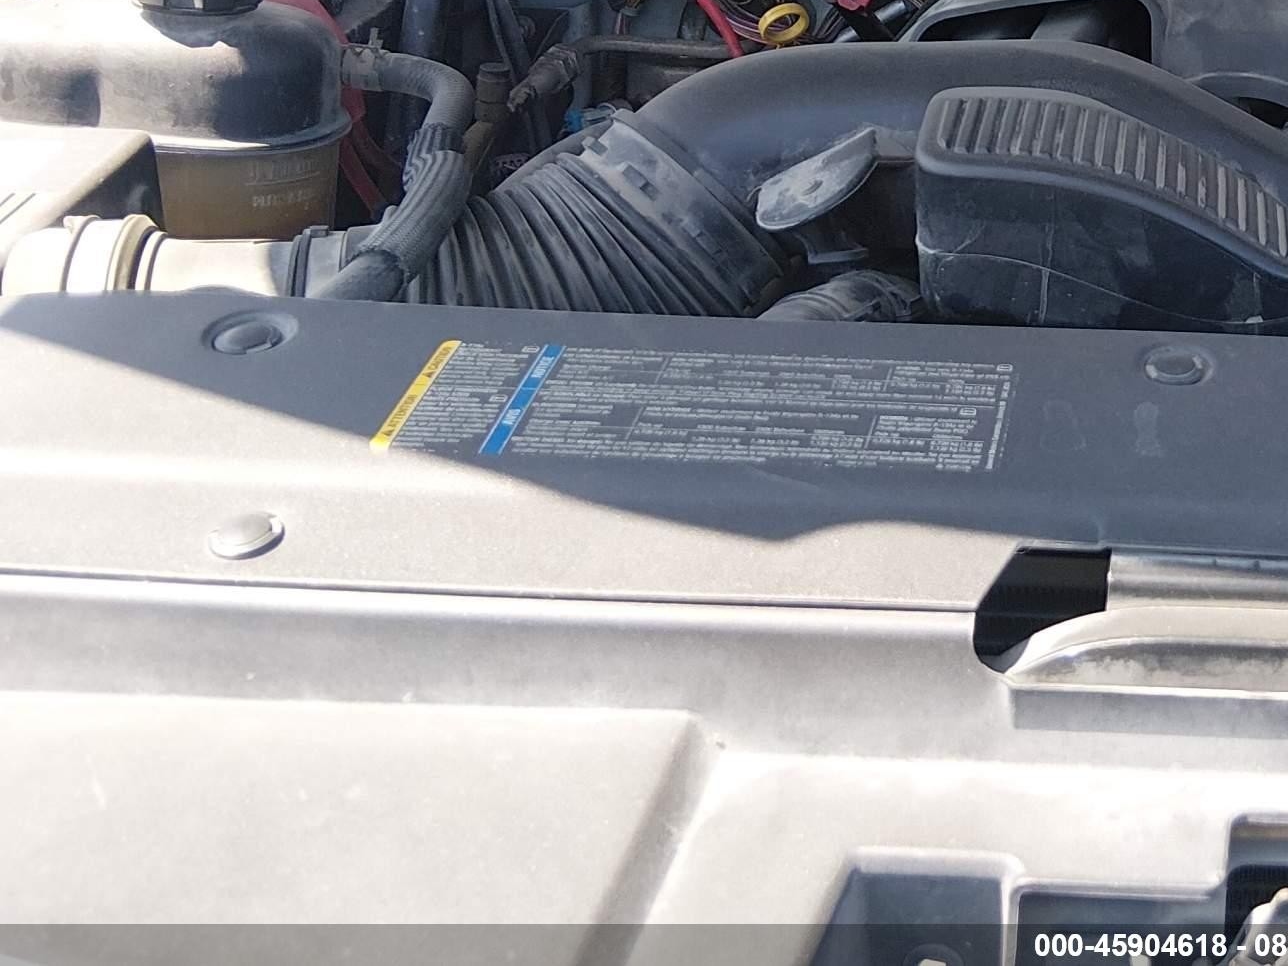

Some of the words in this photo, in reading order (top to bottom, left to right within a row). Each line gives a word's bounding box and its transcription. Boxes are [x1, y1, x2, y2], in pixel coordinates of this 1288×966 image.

[531, 356, 555, 379] NOTICE
[387, 394, 418, 428] ATTENTION
[501, 408, 521, 426] AVIS
